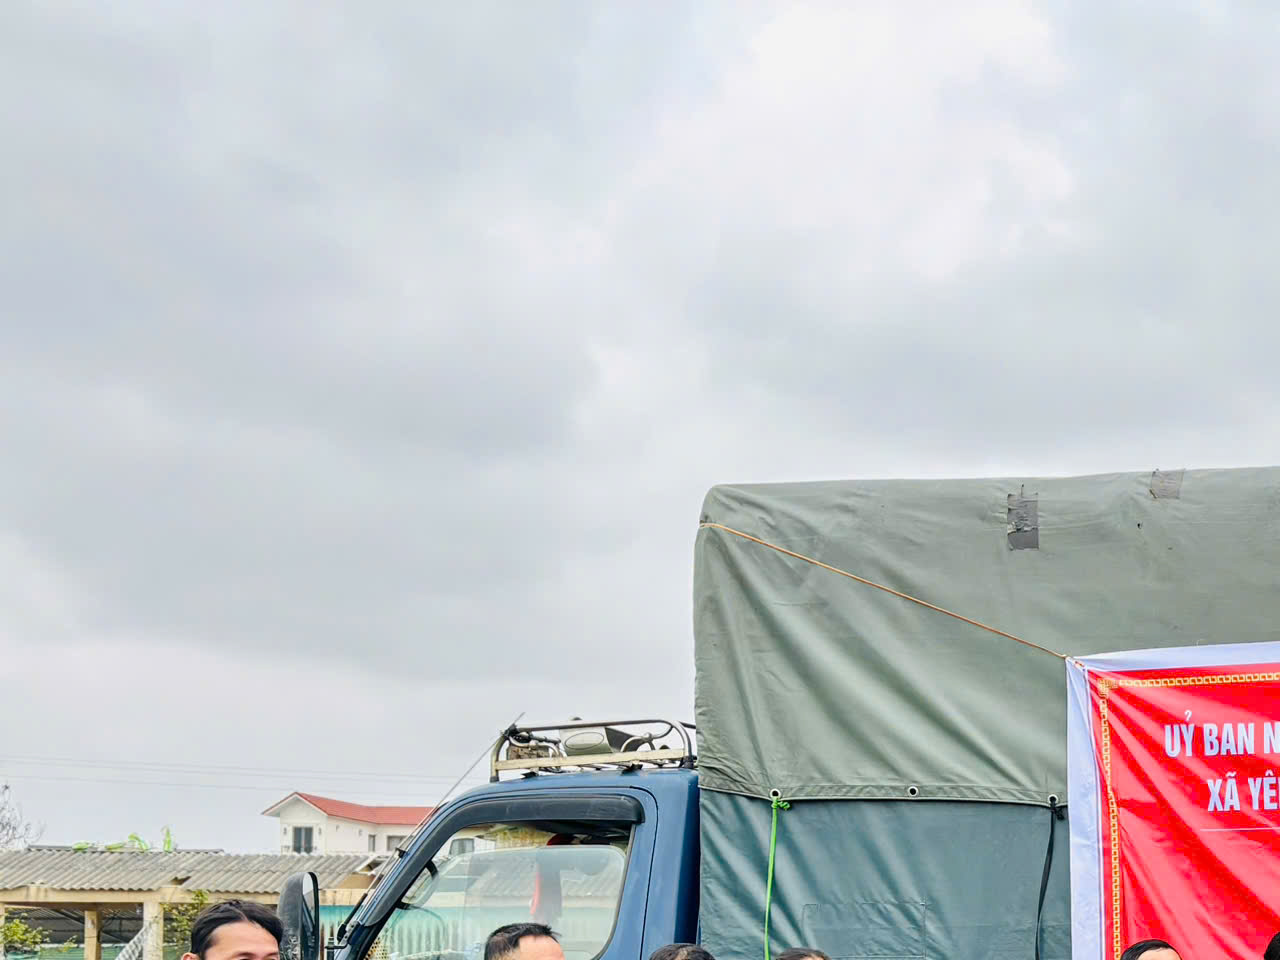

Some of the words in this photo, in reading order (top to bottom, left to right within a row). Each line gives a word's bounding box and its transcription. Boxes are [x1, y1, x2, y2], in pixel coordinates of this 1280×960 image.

[1164, 709, 1195, 758] UỶ
[1203, 722, 1255, 757] BAN
[1207, 771, 1241, 812] XÃ
